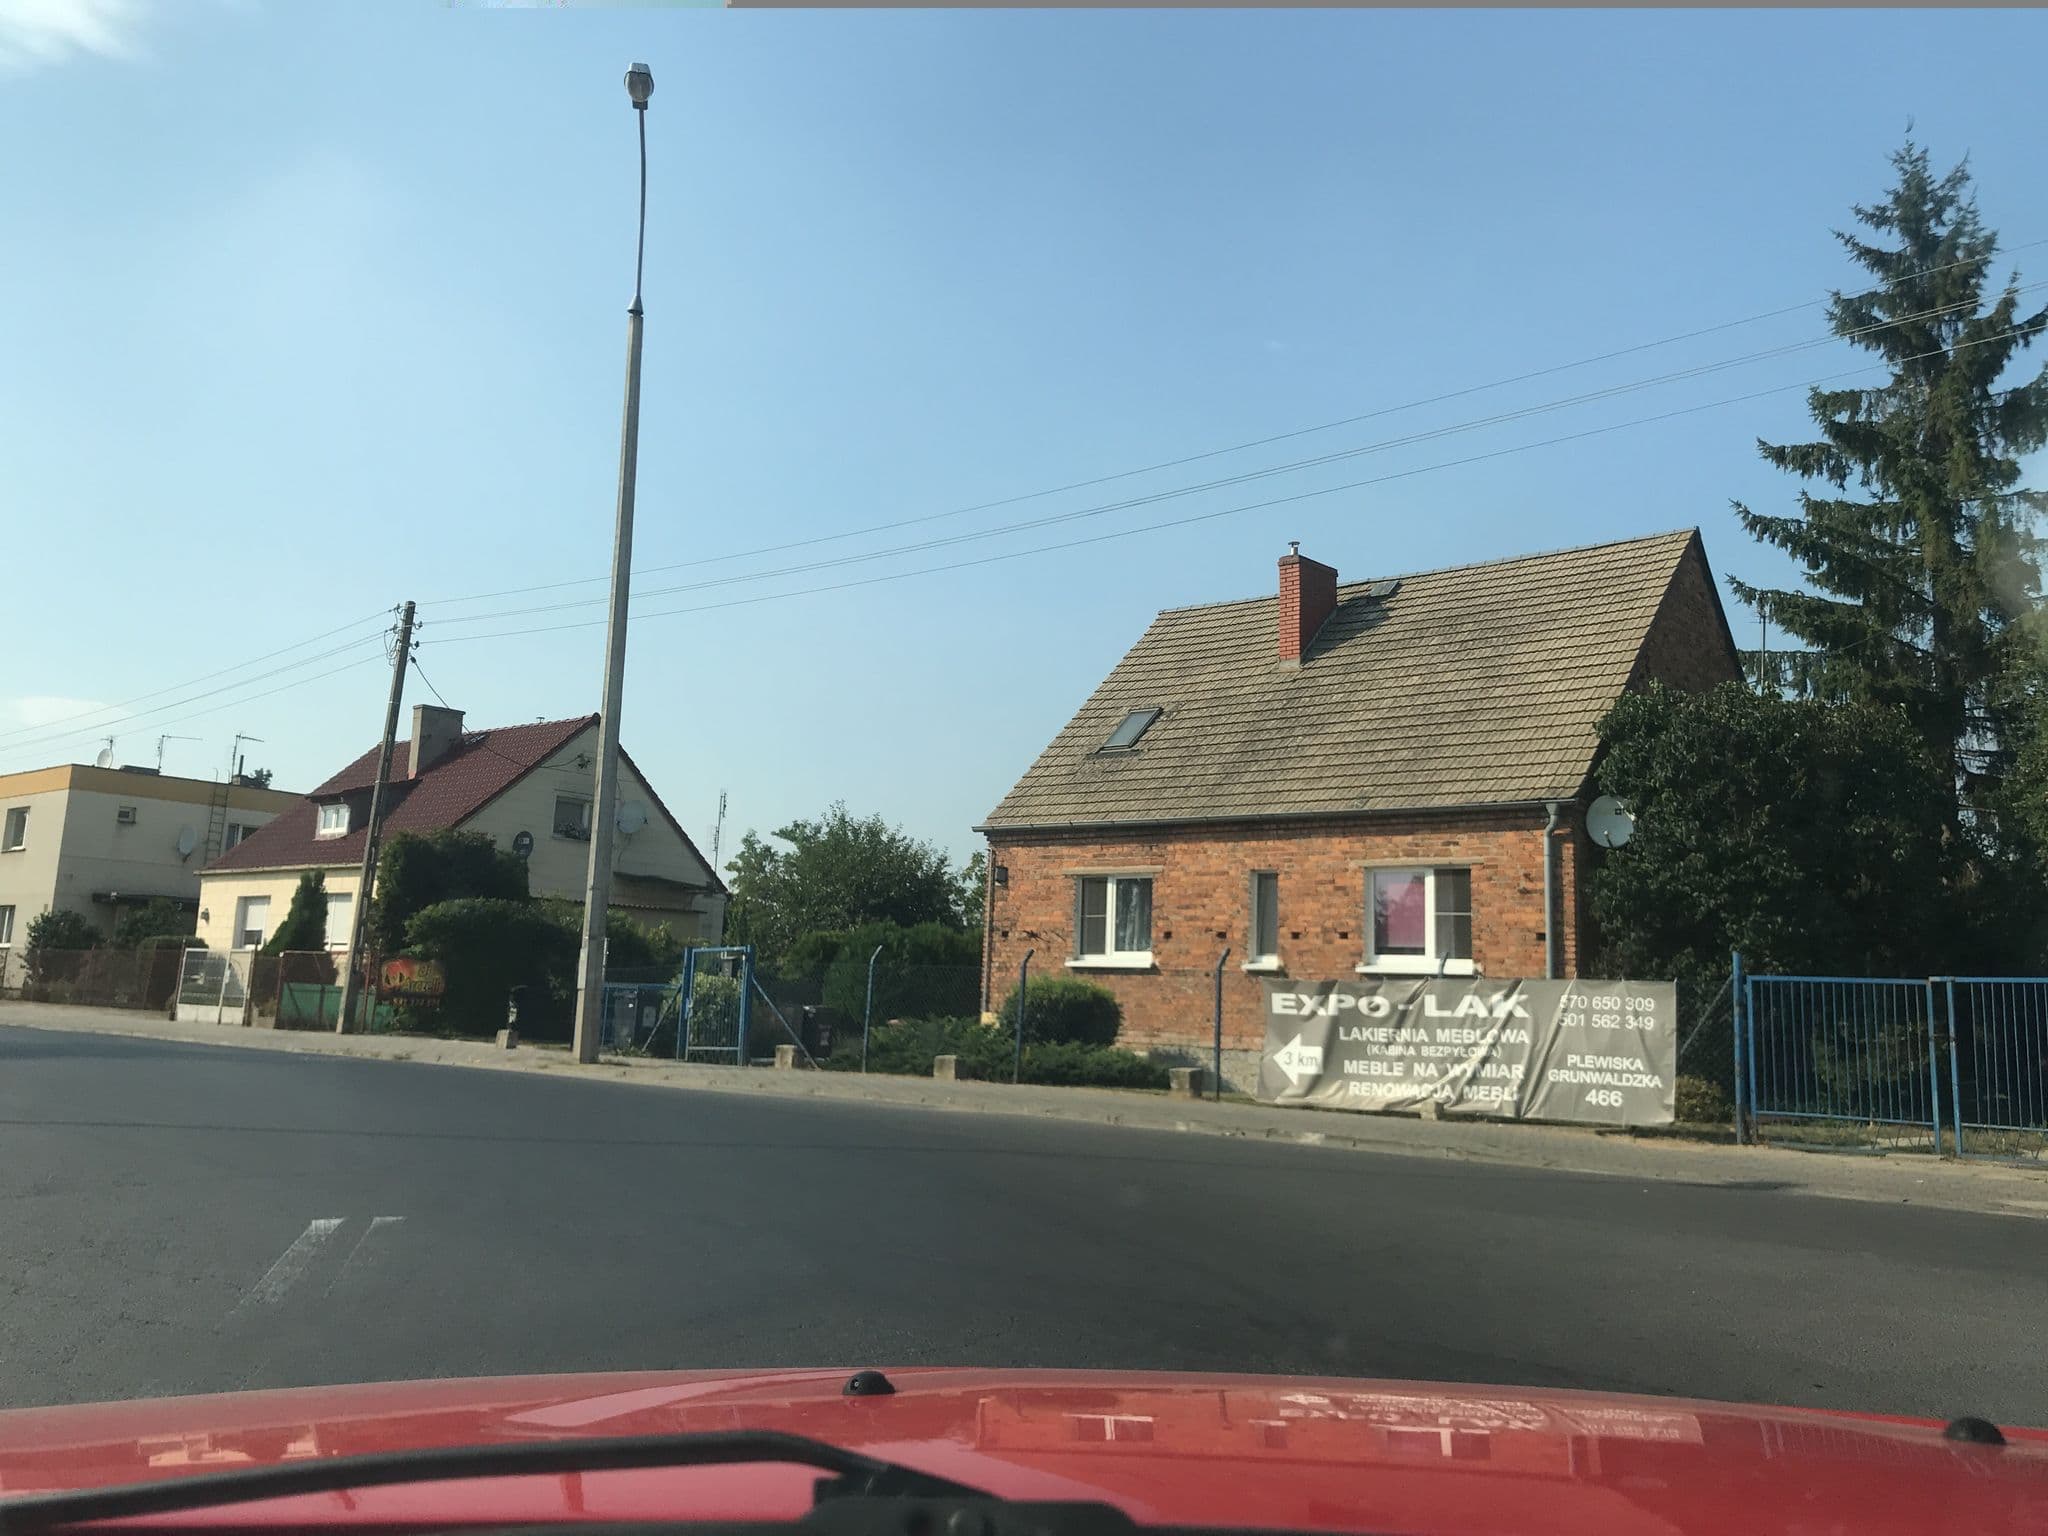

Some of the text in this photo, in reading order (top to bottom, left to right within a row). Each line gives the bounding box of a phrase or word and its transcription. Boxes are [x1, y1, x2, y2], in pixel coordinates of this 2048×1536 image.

[1271, 992, 1390, 1018] EXPO
[1424, 994, 1530, 1018] LAK
[1592, 996, 1620, 1010] 650
[1624, 997, 1655, 1012] 309
[1591, 1014, 1621, 1029] 562
[1624, 1015, 1655, 1031] 349
[1339, 1026, 1429, 1042] LAKIERNIA
[1283, 1051, 1293, 1066] 3
[1567, 1054, 1644, 1071] PLEWISKA
[1343, 1059, 1404, 1077] MEBLE
[1413, 1061, 1439, 1078] NA
[1547, 1068, 1662, 1088] GRUNWALDZKA
[1585, 1088, 1623, 1107] 466
